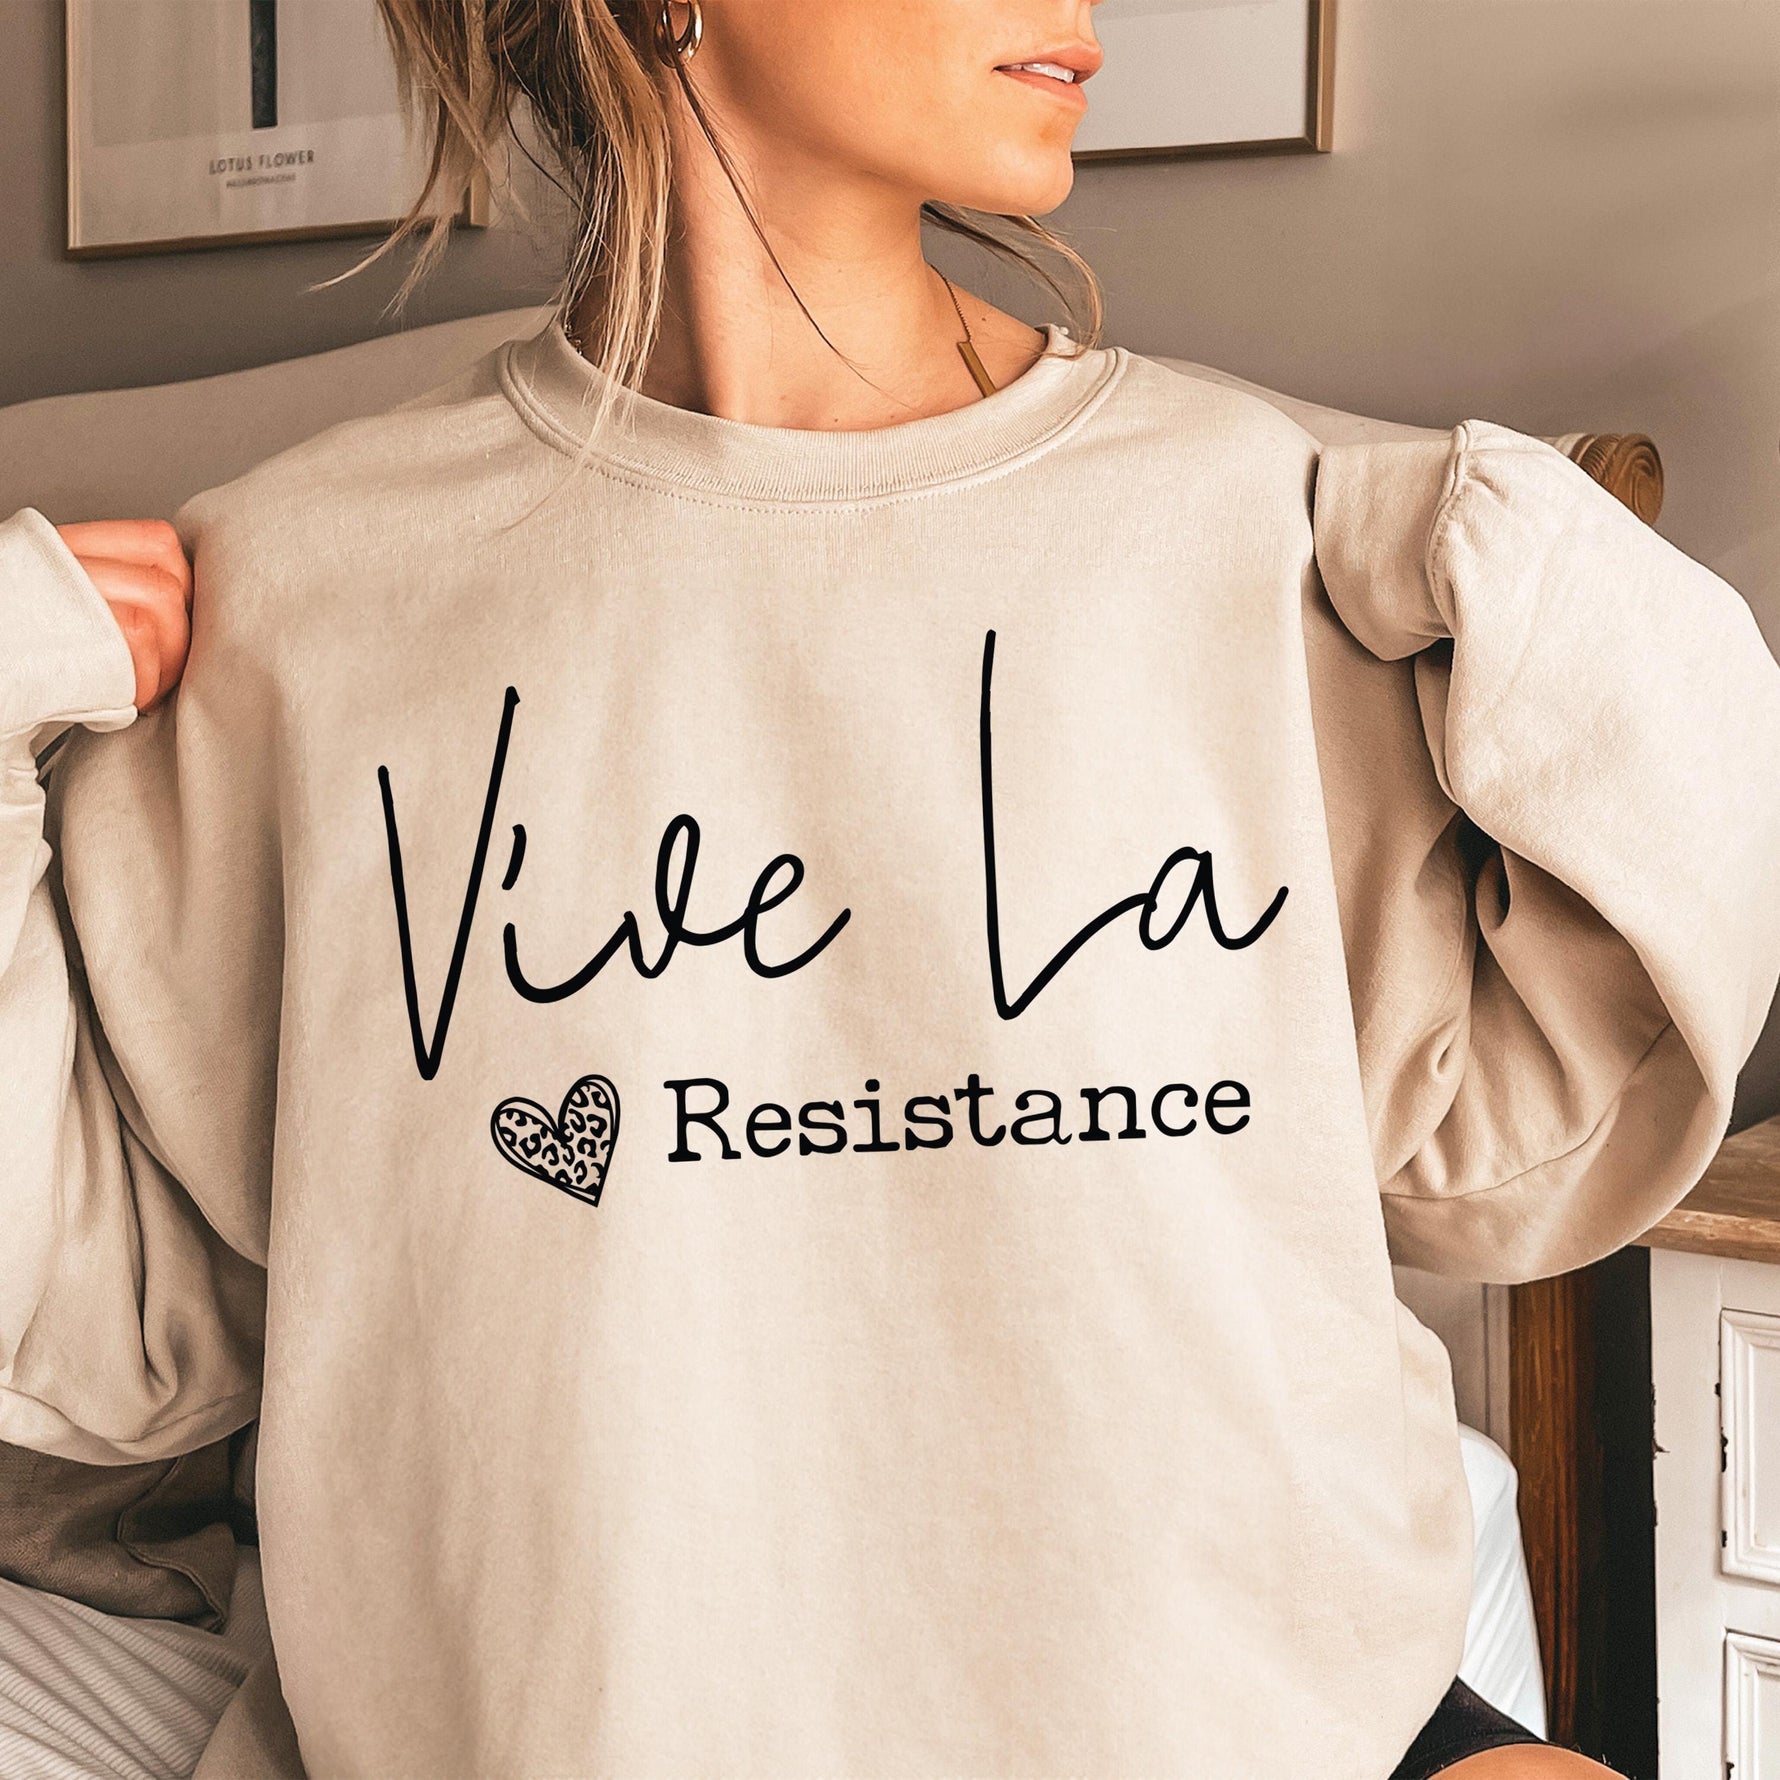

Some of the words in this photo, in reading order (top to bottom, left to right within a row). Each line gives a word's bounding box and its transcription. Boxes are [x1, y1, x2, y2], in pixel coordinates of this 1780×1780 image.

[209, 156, 252, 175] LOTUS
[259, 150, 314, 168] FLOWER
[378, 686, 852, 1081] Vive
[980, 630, 1289, 1021] La
[664, 1074, 1251, 1163] Resistance
